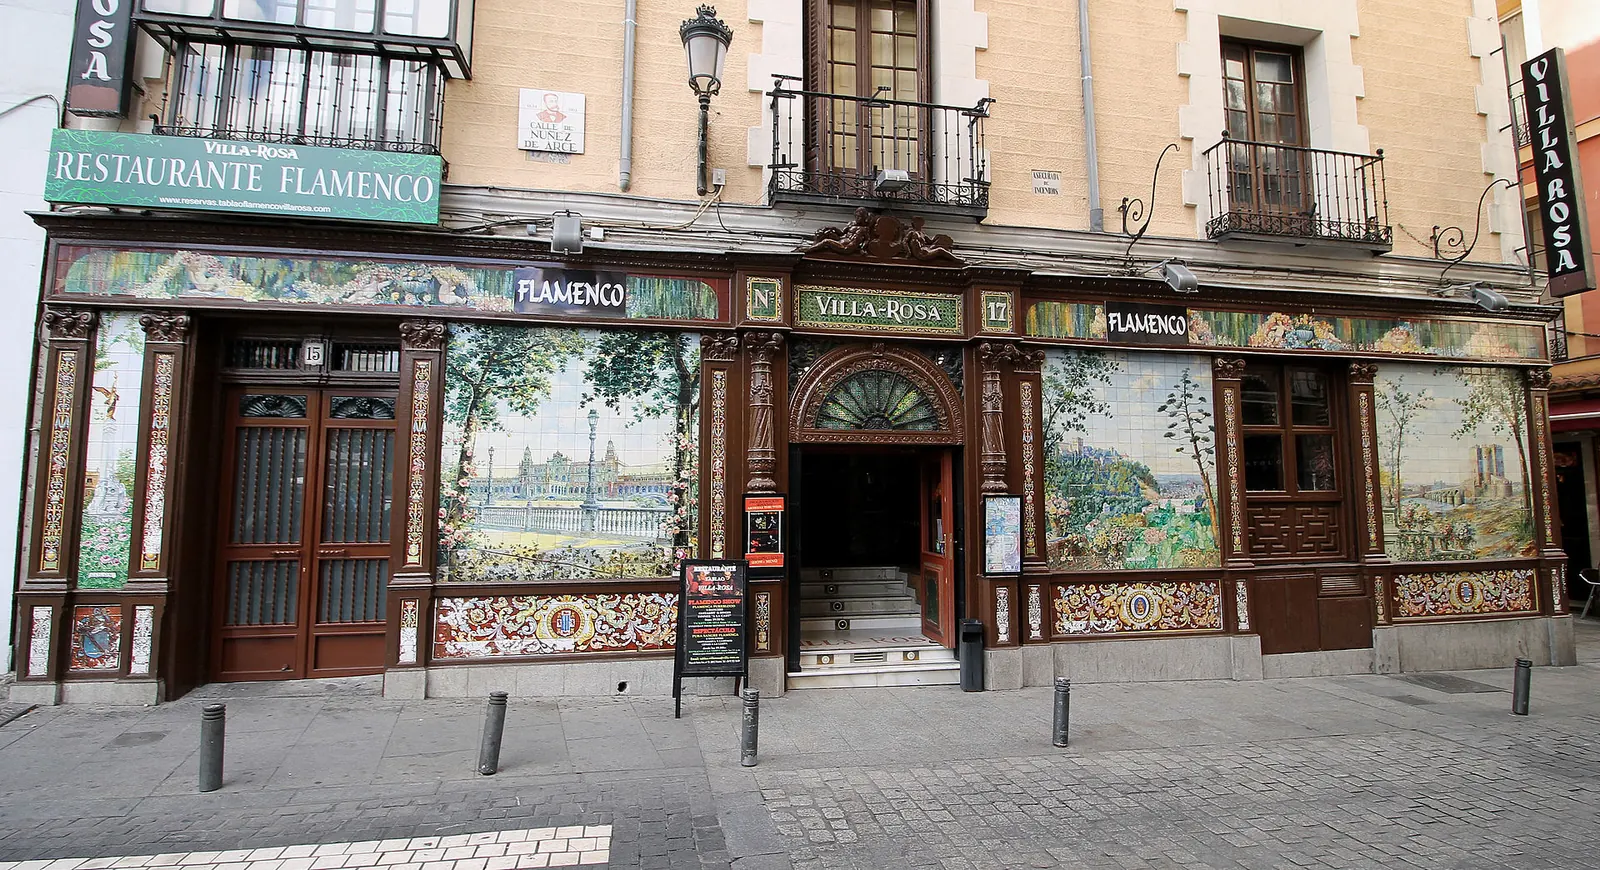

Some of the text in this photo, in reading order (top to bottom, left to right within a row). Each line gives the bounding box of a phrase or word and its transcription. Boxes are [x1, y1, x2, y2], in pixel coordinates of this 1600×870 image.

[530, 121, 557, 130] CALLE
[204, 140, 299, 161] VILLA-ROSA
[524, 140, 578, 152] DE ARCE
[1530, 57, 1577, 273] VILLA ROSA
[54, 151, 433, 204] RESTAURANTE FLAMENCO
[159, 196, 331, 213] www.reservas.tablaoflamencovillarosa.com
[517, 279, 624, 307] FLAMENCO
[815, 295, 942, 323] VILLA-ROSA
[987, 302, 1007, 322] 17
[1108, 312, 1186, 335] FLAMENCO
[306, 346, 321, 361] 15
